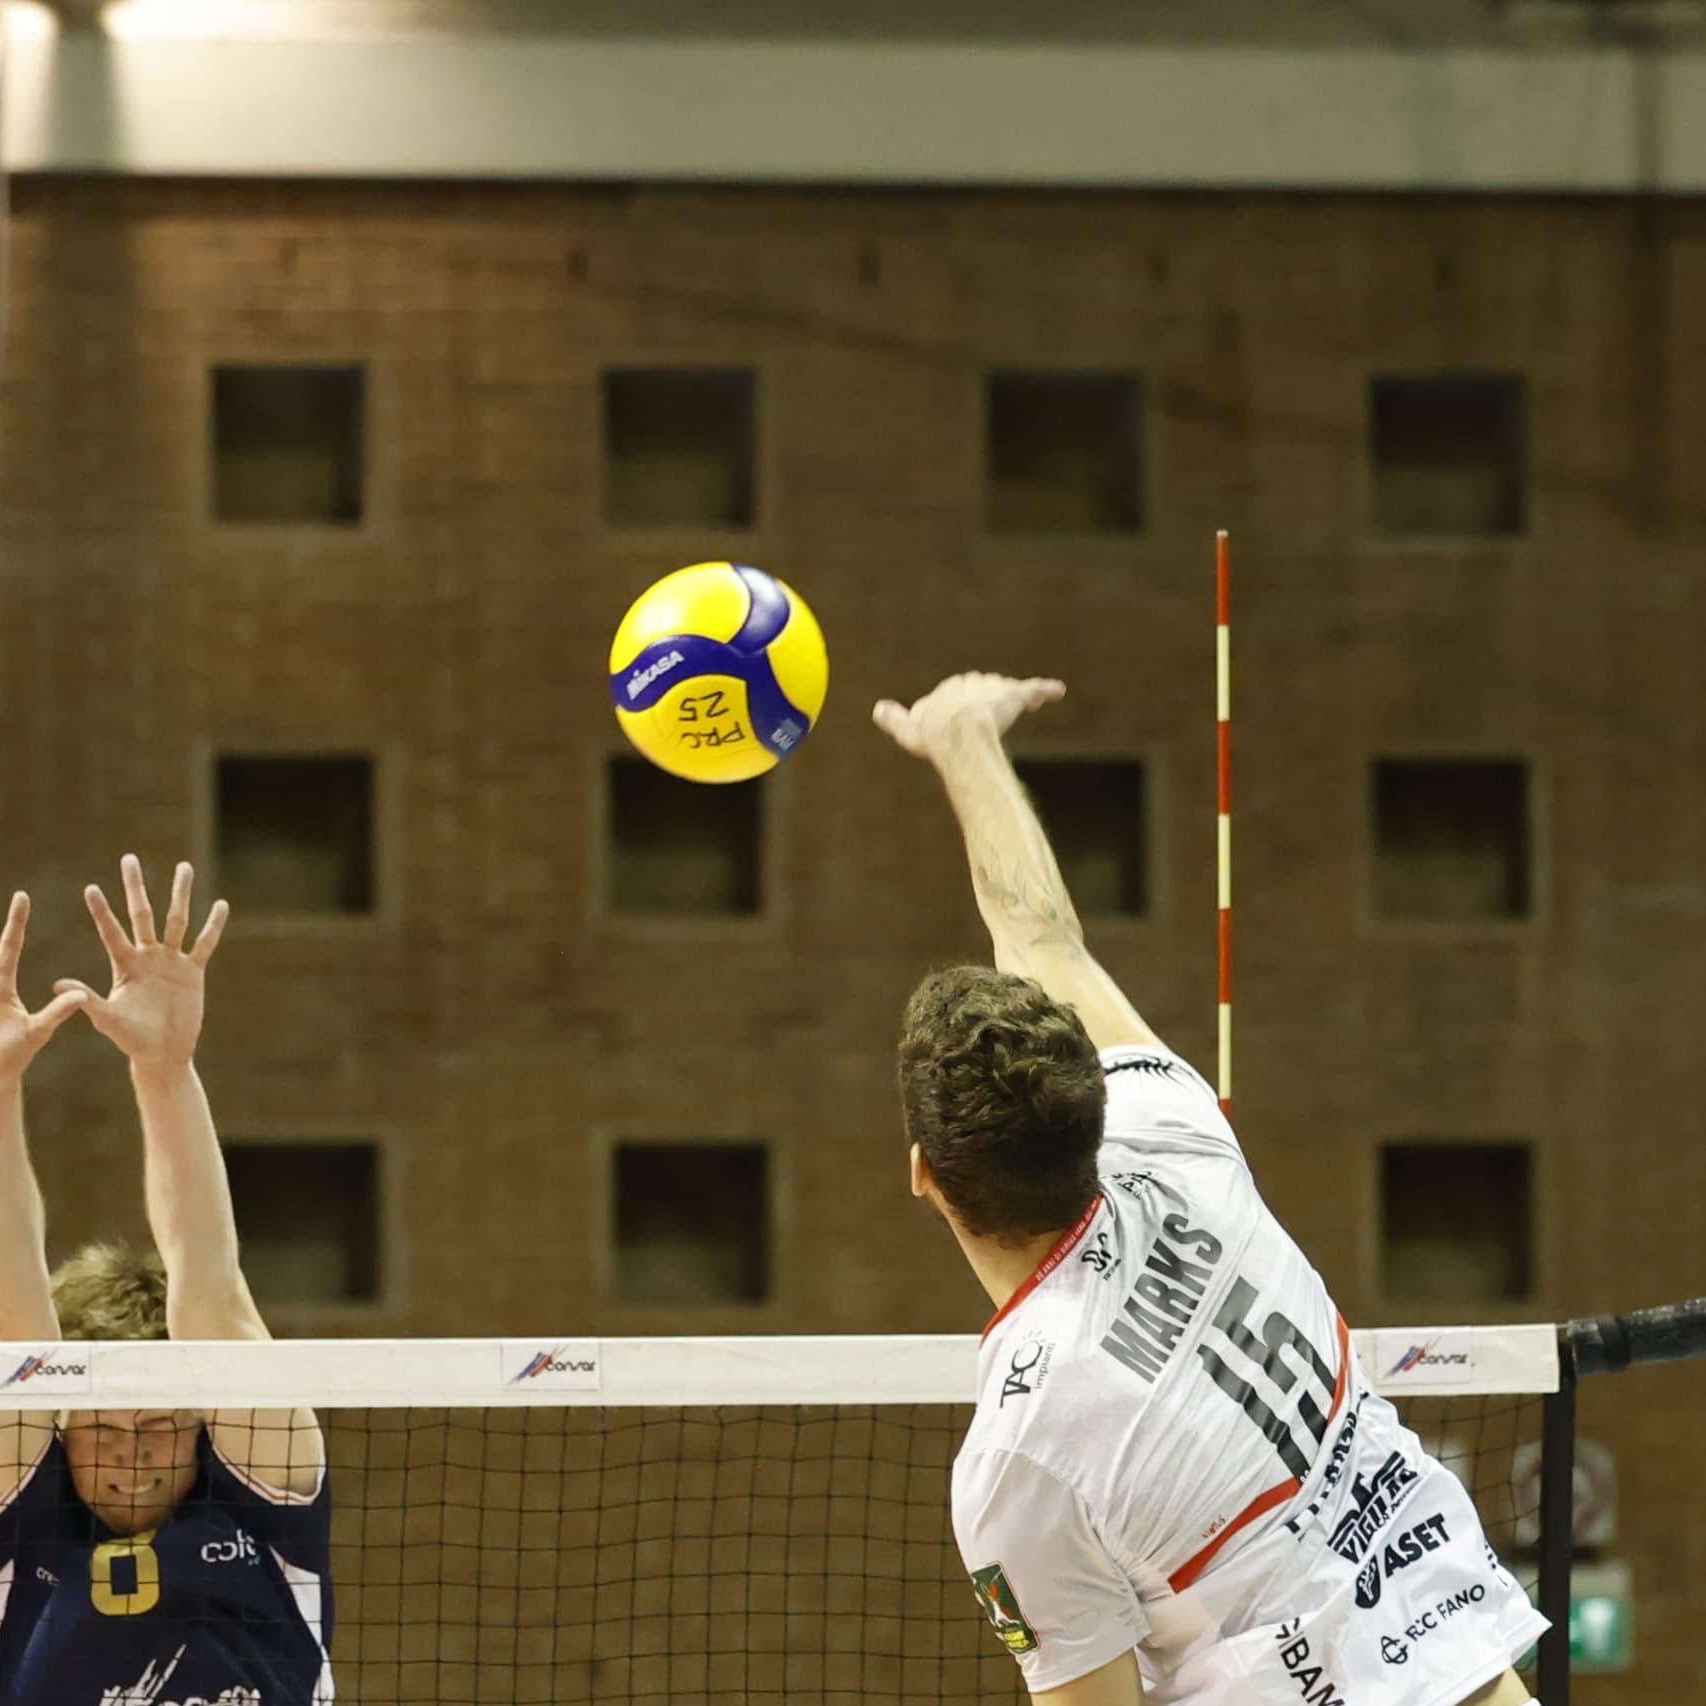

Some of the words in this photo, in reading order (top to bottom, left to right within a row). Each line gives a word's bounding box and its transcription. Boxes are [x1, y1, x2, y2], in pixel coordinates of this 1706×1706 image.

[626, 650, 684, 700] MIKASA
[679, 691, 730, 722] 25
[1100, 1213, 1223, 1384] MARKS
[1196, 1276, 1337, 1484] 15
[90, 1534, 160, 1616] 0
[1384, 1512, 1451, 1579] ASET
[1437, 1583, 1486, 1622] FANO
